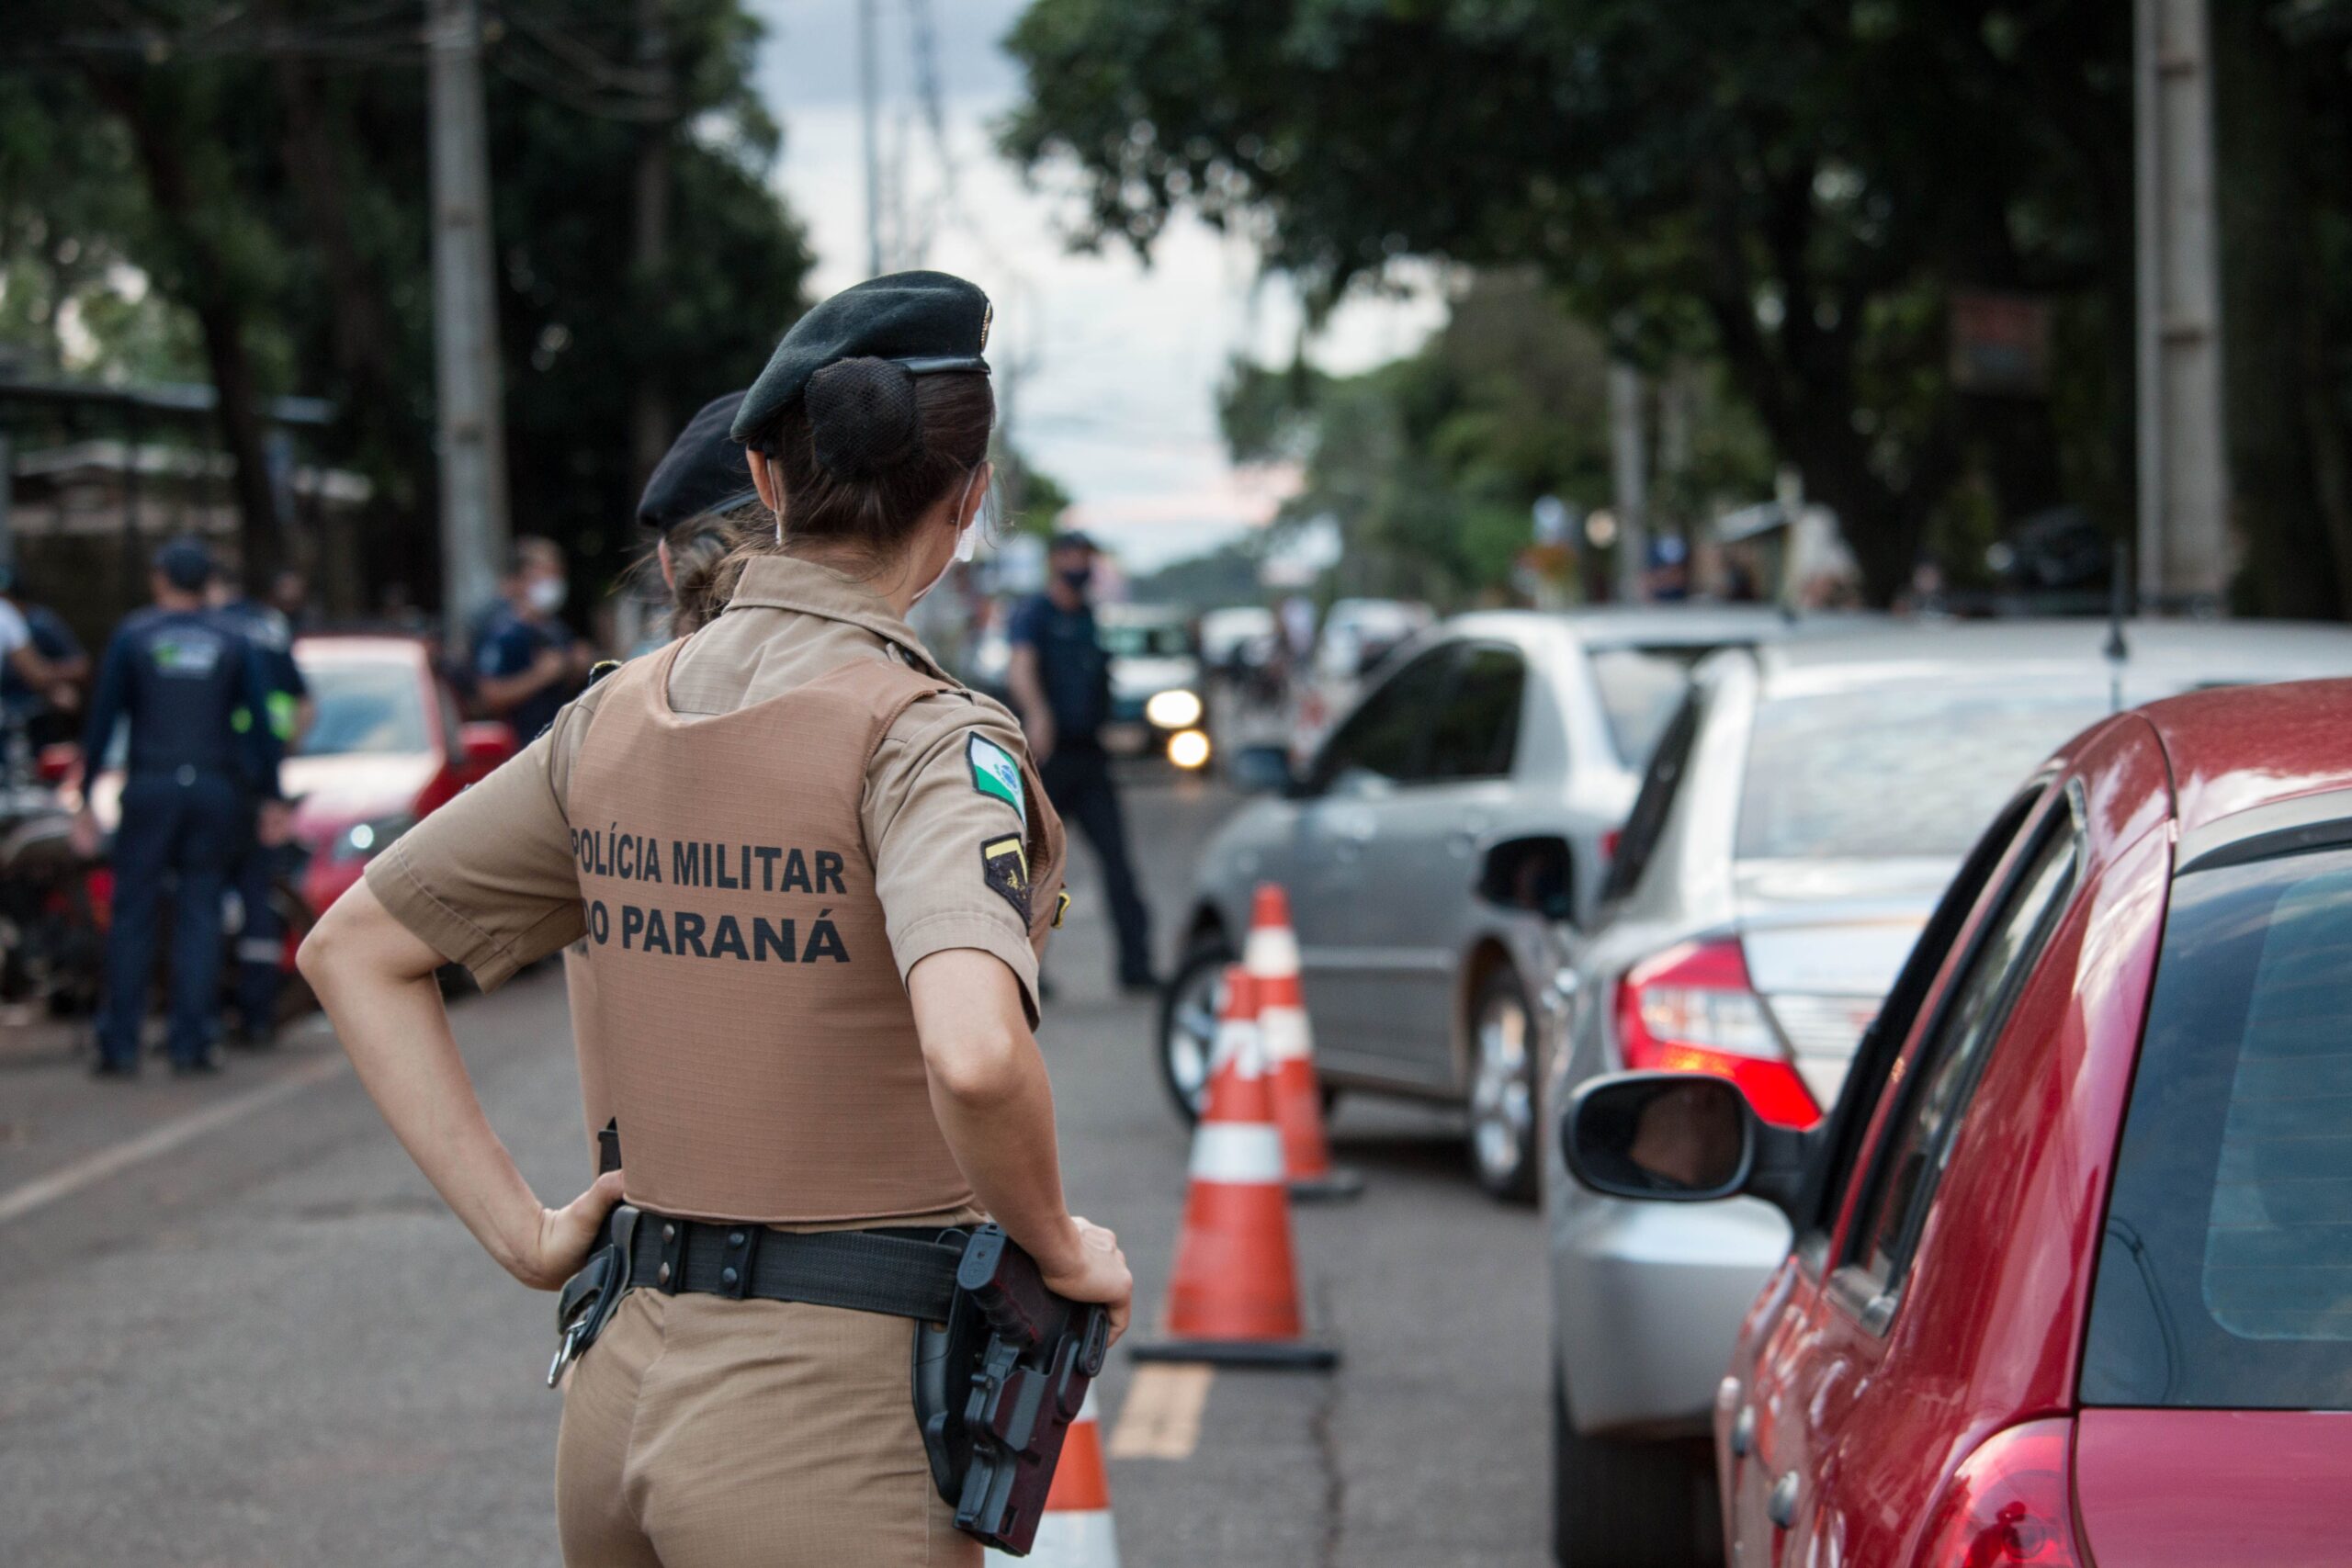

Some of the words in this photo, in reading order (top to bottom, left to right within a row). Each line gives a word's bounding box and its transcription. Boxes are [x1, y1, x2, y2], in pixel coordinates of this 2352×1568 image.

[571, 822, 662, 883] POLÍCIA
[673, 840, 847, 895] MILITAR
[622, 905, 851, 963] PARANÁ
